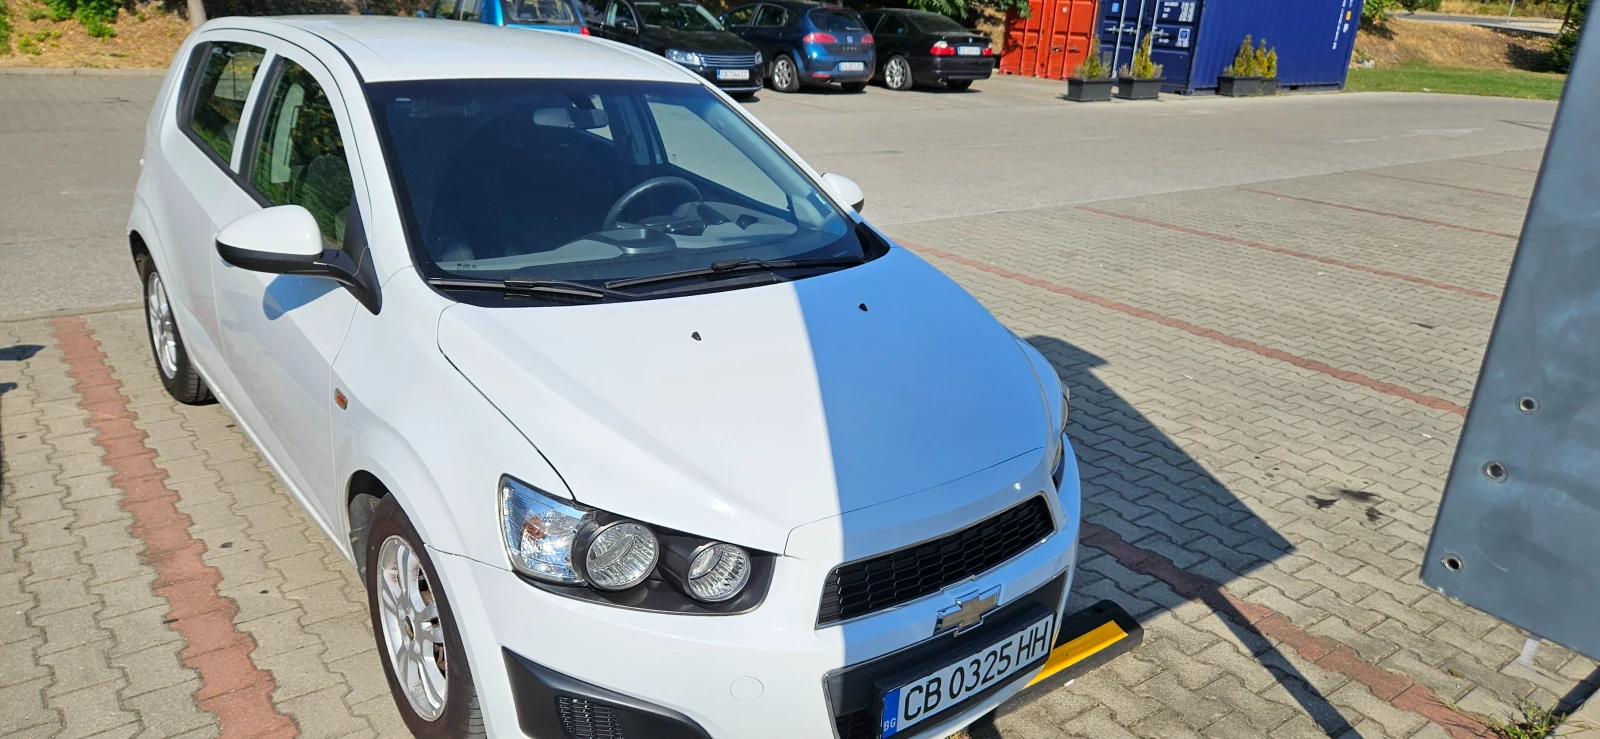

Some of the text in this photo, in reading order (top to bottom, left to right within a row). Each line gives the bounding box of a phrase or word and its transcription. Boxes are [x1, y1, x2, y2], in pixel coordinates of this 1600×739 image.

[903, 621, 1050, 721] CB 0325 HH
[883, 717, 896, 732] BG
